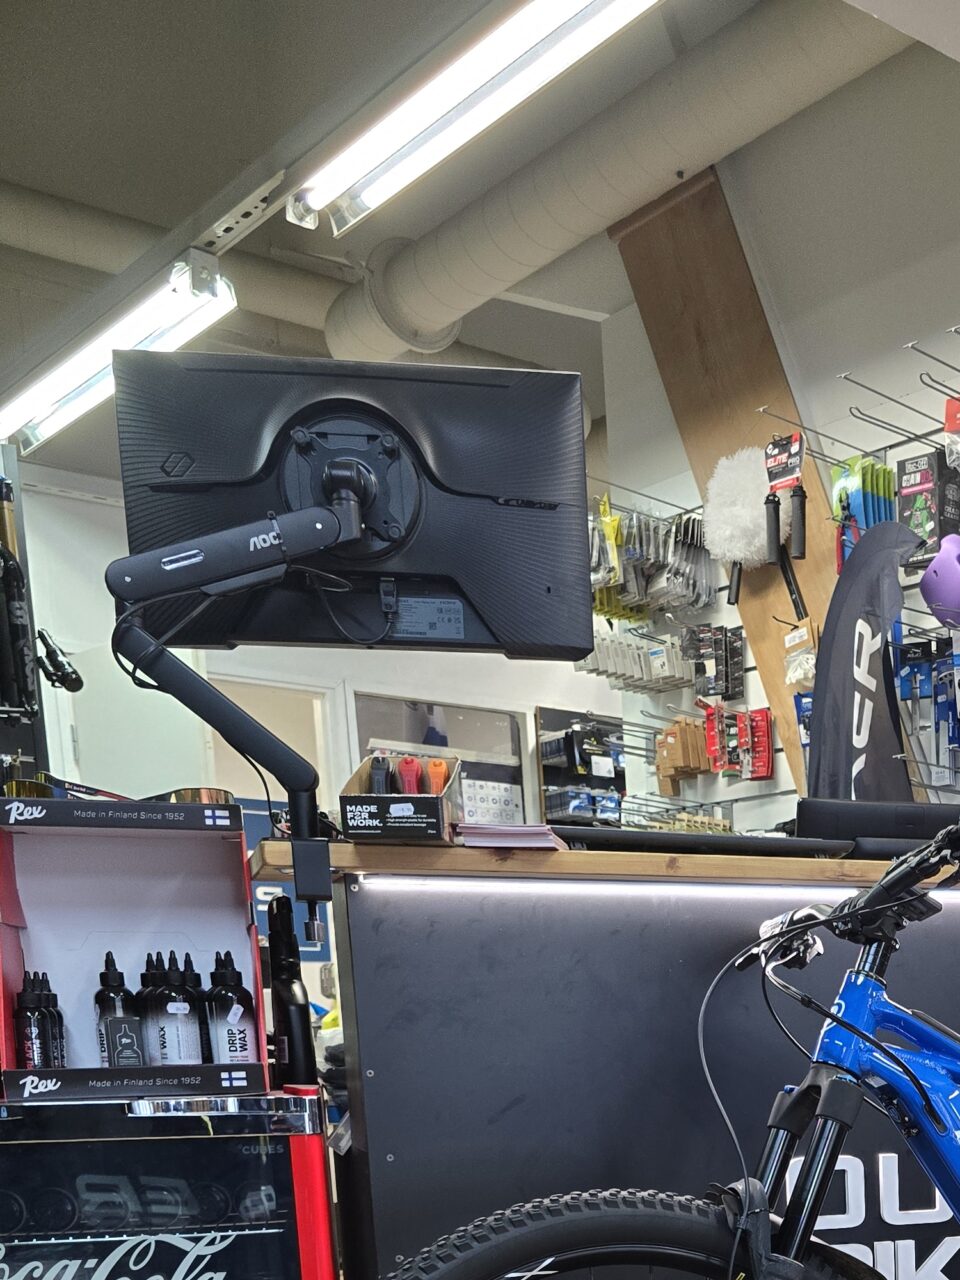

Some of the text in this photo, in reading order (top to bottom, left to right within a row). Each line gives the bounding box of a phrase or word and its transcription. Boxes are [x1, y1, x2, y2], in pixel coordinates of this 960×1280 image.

[5, 801, 185, 824] Rex Made in Finland Since 1952
[346, 805, 378, 813] MADE
[348, 819, 383, 827] WORK.
[159, 1026, 167, 1050] WAX
[229, 1028, 239, 1053] DRIP
[238, 1028, 249, 1053] WAX
[19, 1075, 61, 1097] Rex
[88, 1079, 112, 1088] Made
[123, 1077, 154, 1086] Finland
[156, 1077, 179, 1086] Since
[181, 1076, 202, 1085] 1952
